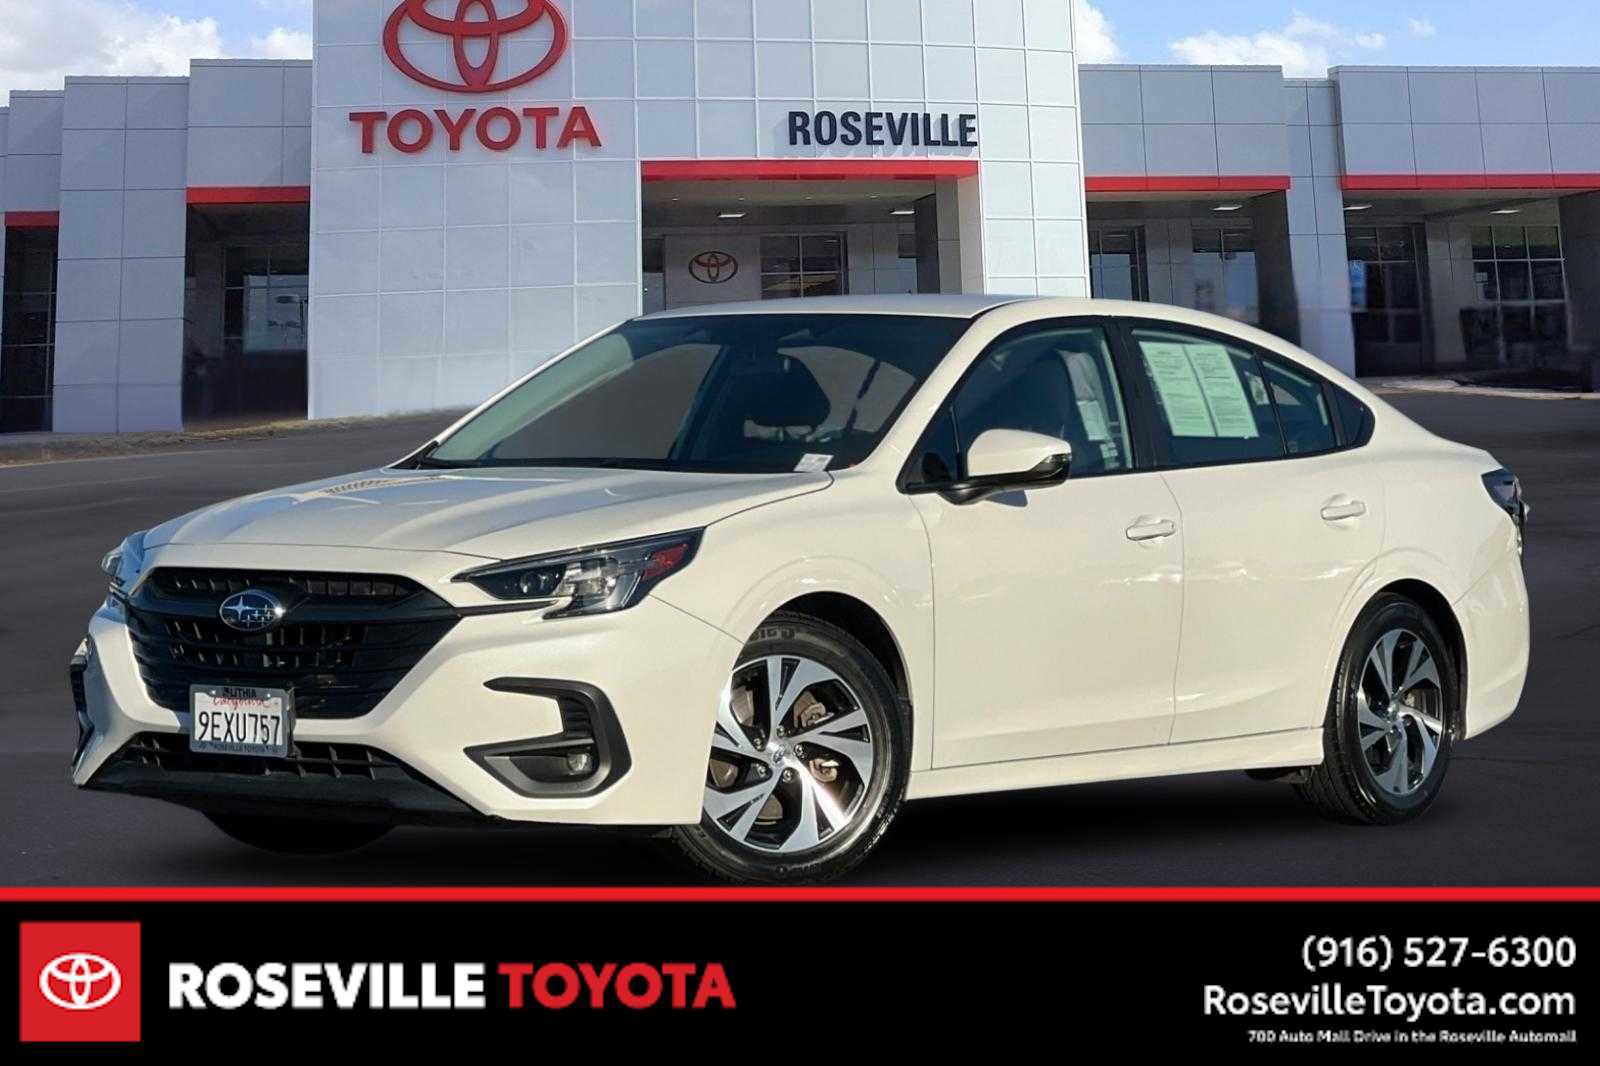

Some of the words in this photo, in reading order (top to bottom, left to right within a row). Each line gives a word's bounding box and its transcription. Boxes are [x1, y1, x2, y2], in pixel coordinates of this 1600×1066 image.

[349, 106, 602, 154] TOYOTA
[788, 110, 979, 147] ROSEVILLE
[198, 711, 281, 747] 9EXU757
